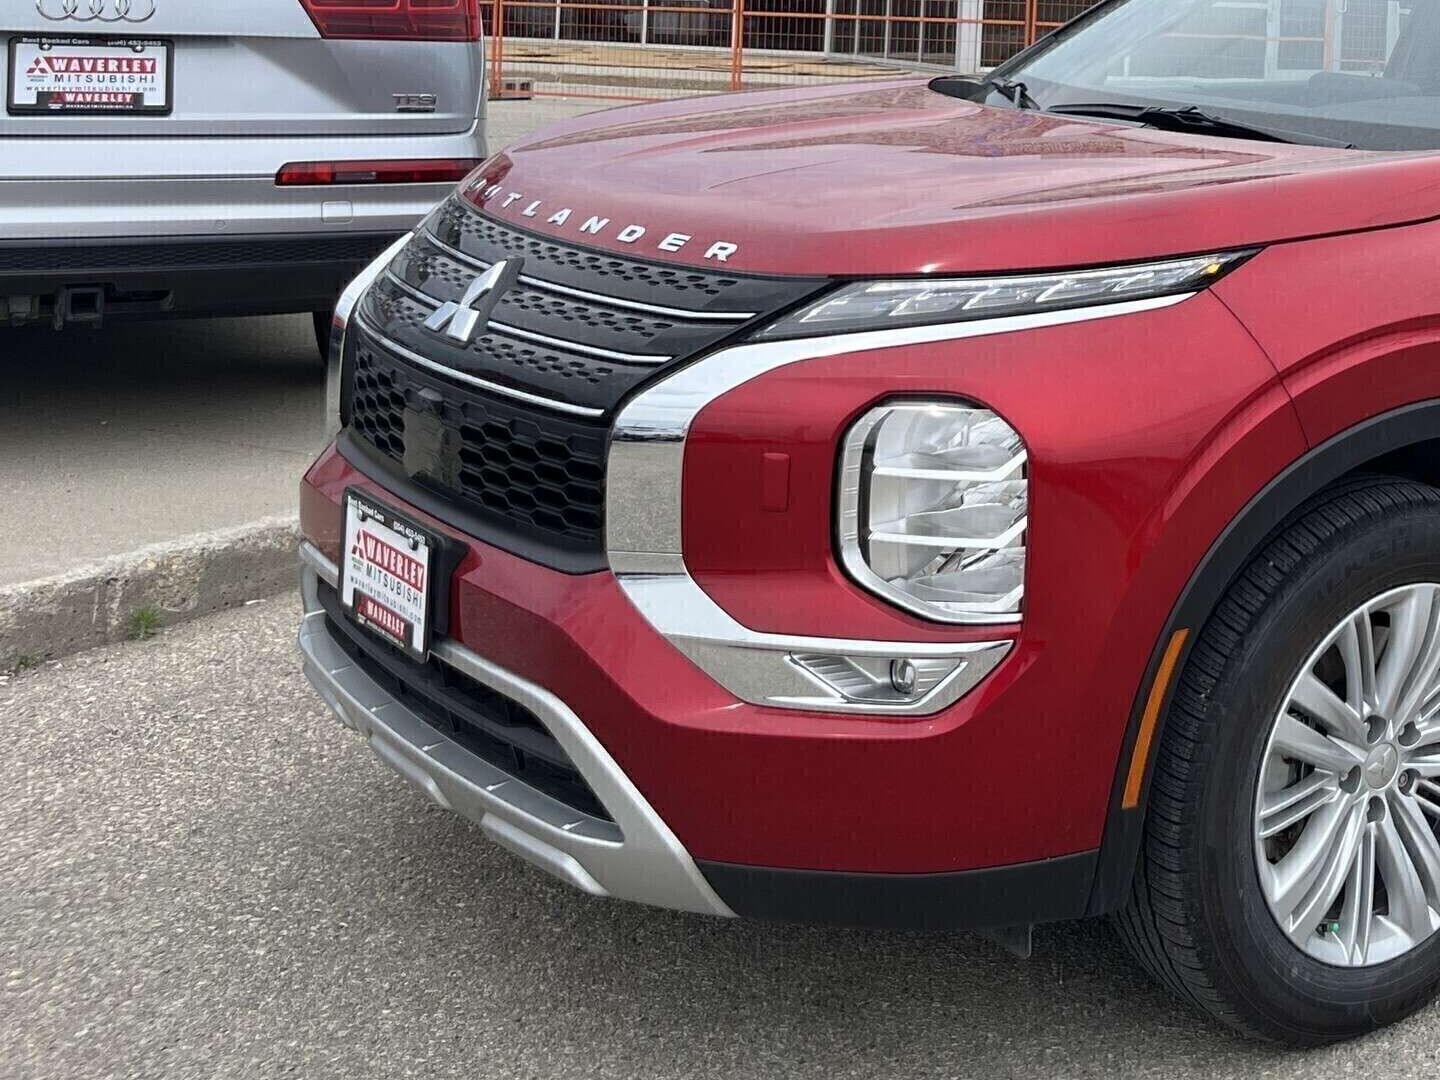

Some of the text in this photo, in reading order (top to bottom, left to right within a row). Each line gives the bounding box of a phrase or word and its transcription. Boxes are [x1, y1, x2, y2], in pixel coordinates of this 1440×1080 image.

[52, 59, 154, 73] WAVERLEY
[54, 74, 155, 83] MITSUBISHI
[66, 93, 132, 103] WAVERLEY
[468, 179, 738, 262] OUTLANDER
[366, 537, 424, 588] WAVERLEY
[367, 563, 423, 610] MITSUBISHI
[367, 599, 405, 636] WAVERLEY
